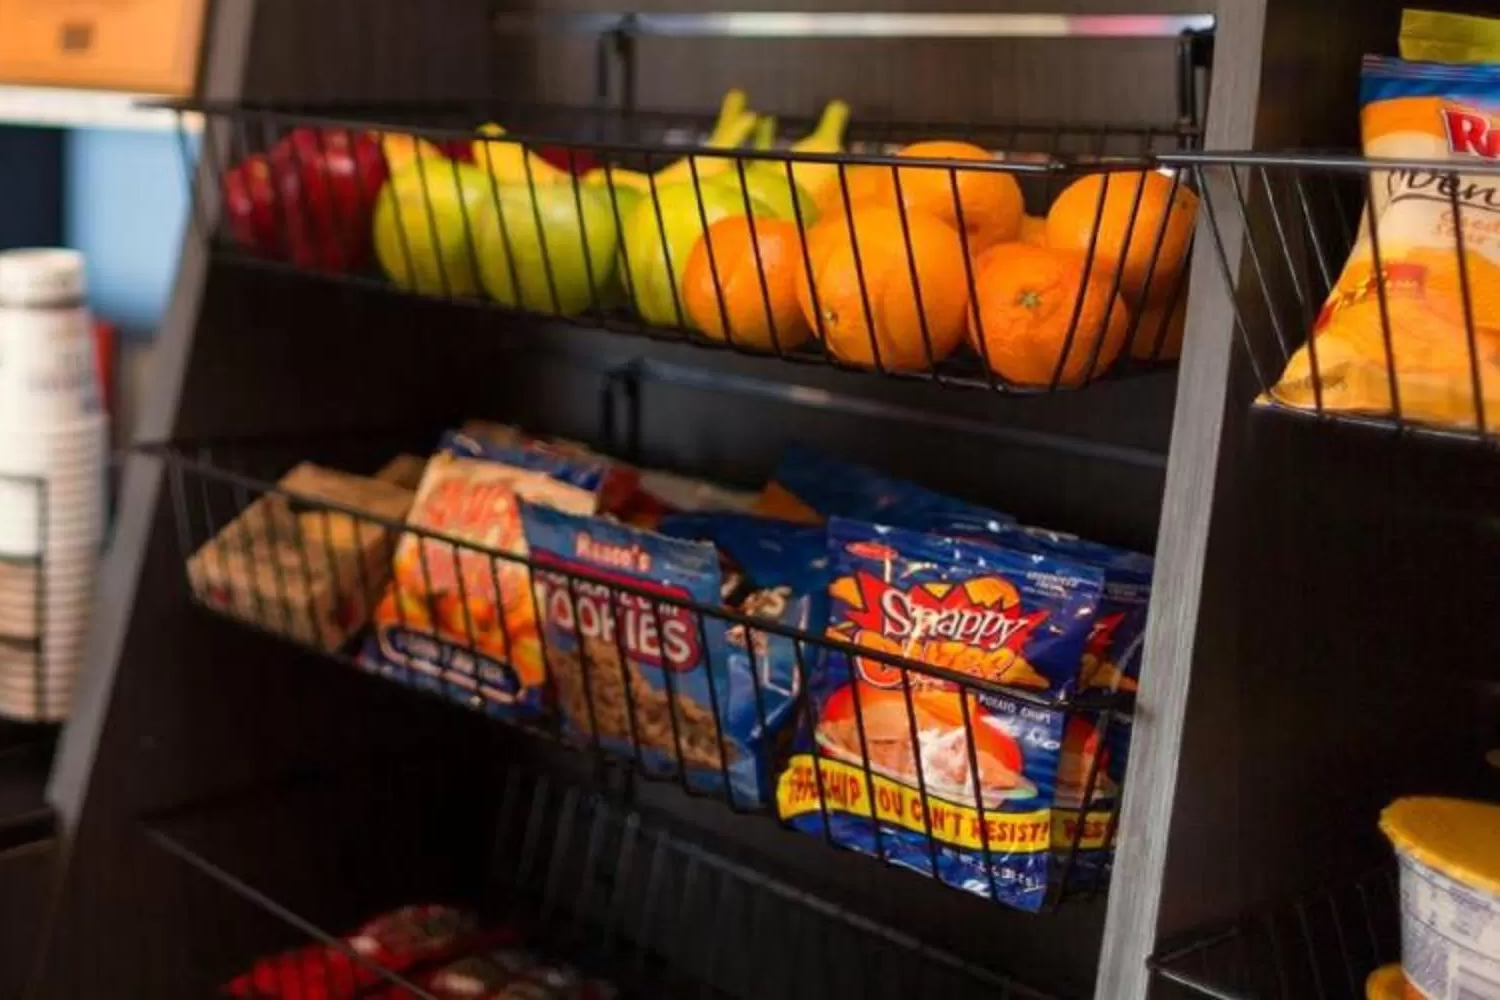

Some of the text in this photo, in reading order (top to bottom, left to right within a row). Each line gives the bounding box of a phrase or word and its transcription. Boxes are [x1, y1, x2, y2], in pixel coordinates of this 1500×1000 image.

[881, 588, 1028, 650] Snappy
[912, 803, 963, 838] CN'T
[971, 817, 1051, 843] RESIST!
